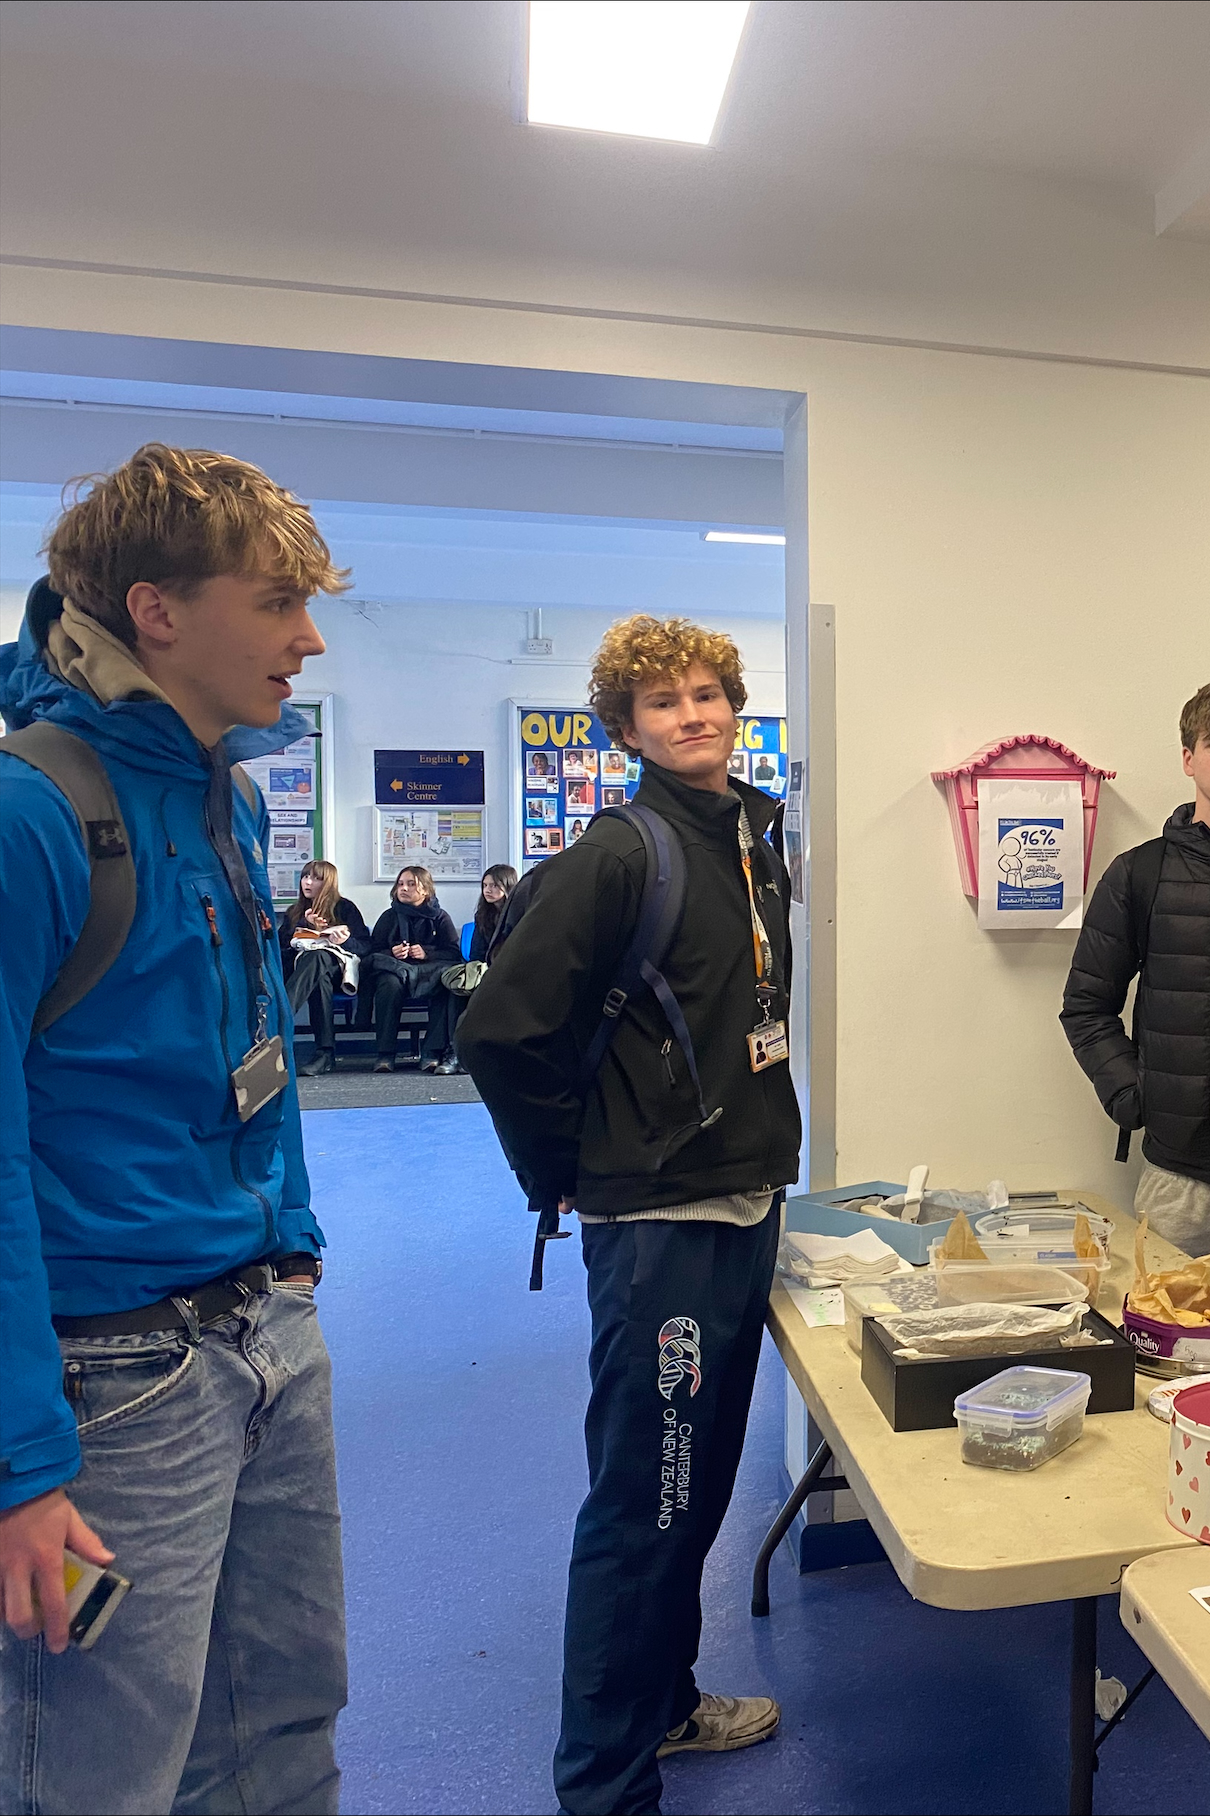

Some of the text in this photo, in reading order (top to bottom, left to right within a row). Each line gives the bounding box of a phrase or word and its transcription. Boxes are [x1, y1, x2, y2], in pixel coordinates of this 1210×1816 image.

[521, 712, 592, 747] OUR
[419, 754, 453, 765] English
[406, 781, 442, 791] Skinner
[406, 791, 437, 800] Centre
[1020, 829, 1056, 845] 96%
[1129, 1332, 1160, 1354] Quality
[657, 1408, 677, 1530] OF NEW ZEALAND
[676, 1423, 692, 1511] CANTERBURY
